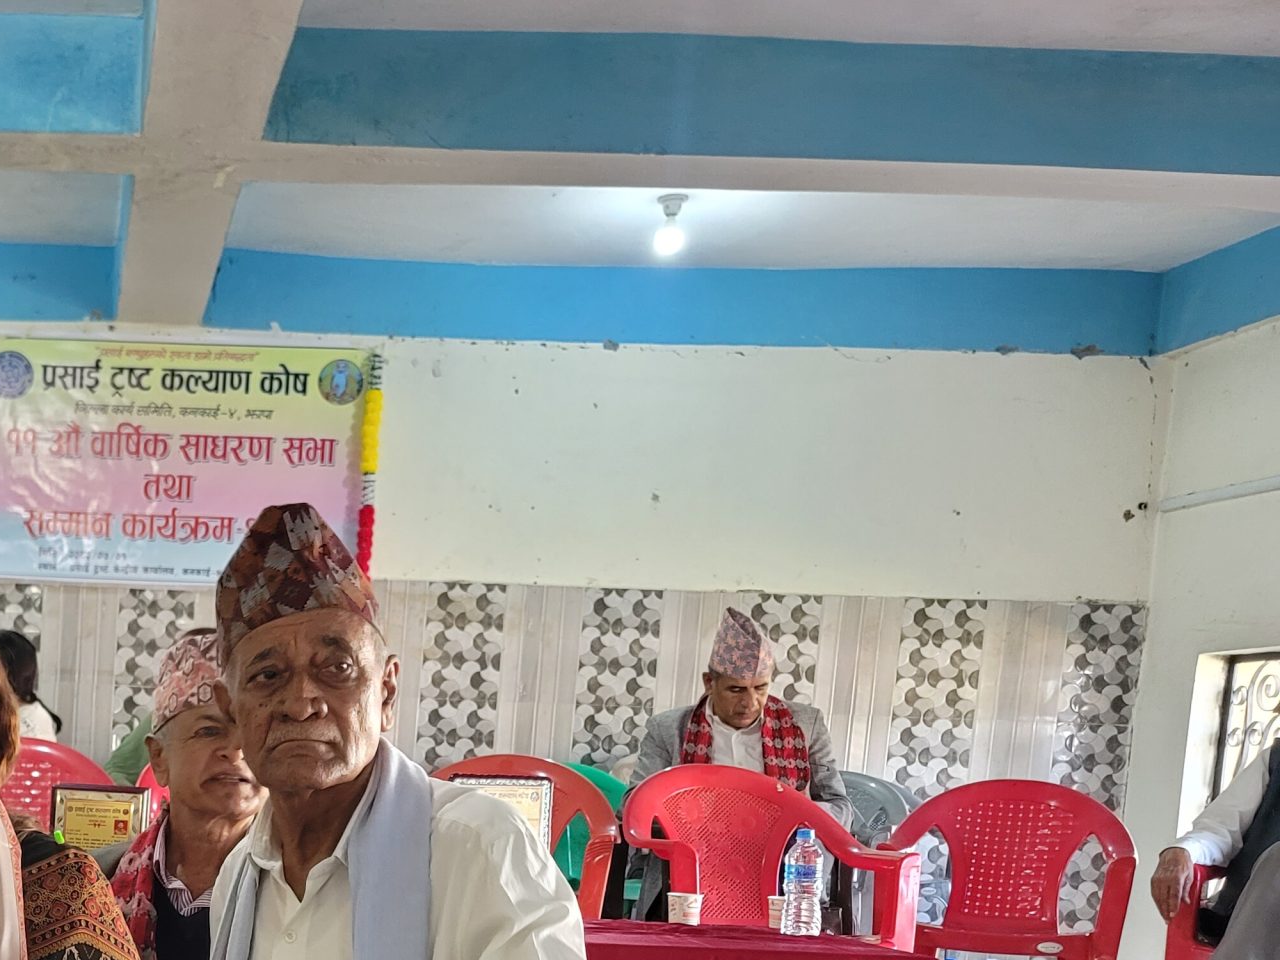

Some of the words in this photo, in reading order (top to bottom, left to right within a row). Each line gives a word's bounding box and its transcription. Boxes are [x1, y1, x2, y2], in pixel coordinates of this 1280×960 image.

[42, 359, 102, 394] प्रसाई
[110, 366, 153, 398] ट्रष्ट
[161, 368, 252, 394] कल्याण
[260, 363, 310, 395] कोष
[91, 422, 173, 460] वार्षिक
[179, 434, 274, 464] साधरण
[282, 437, 337, 467] सभा
[143, 474, 194, 501] तथा
[23, 510, 112, 540] सम्मान
